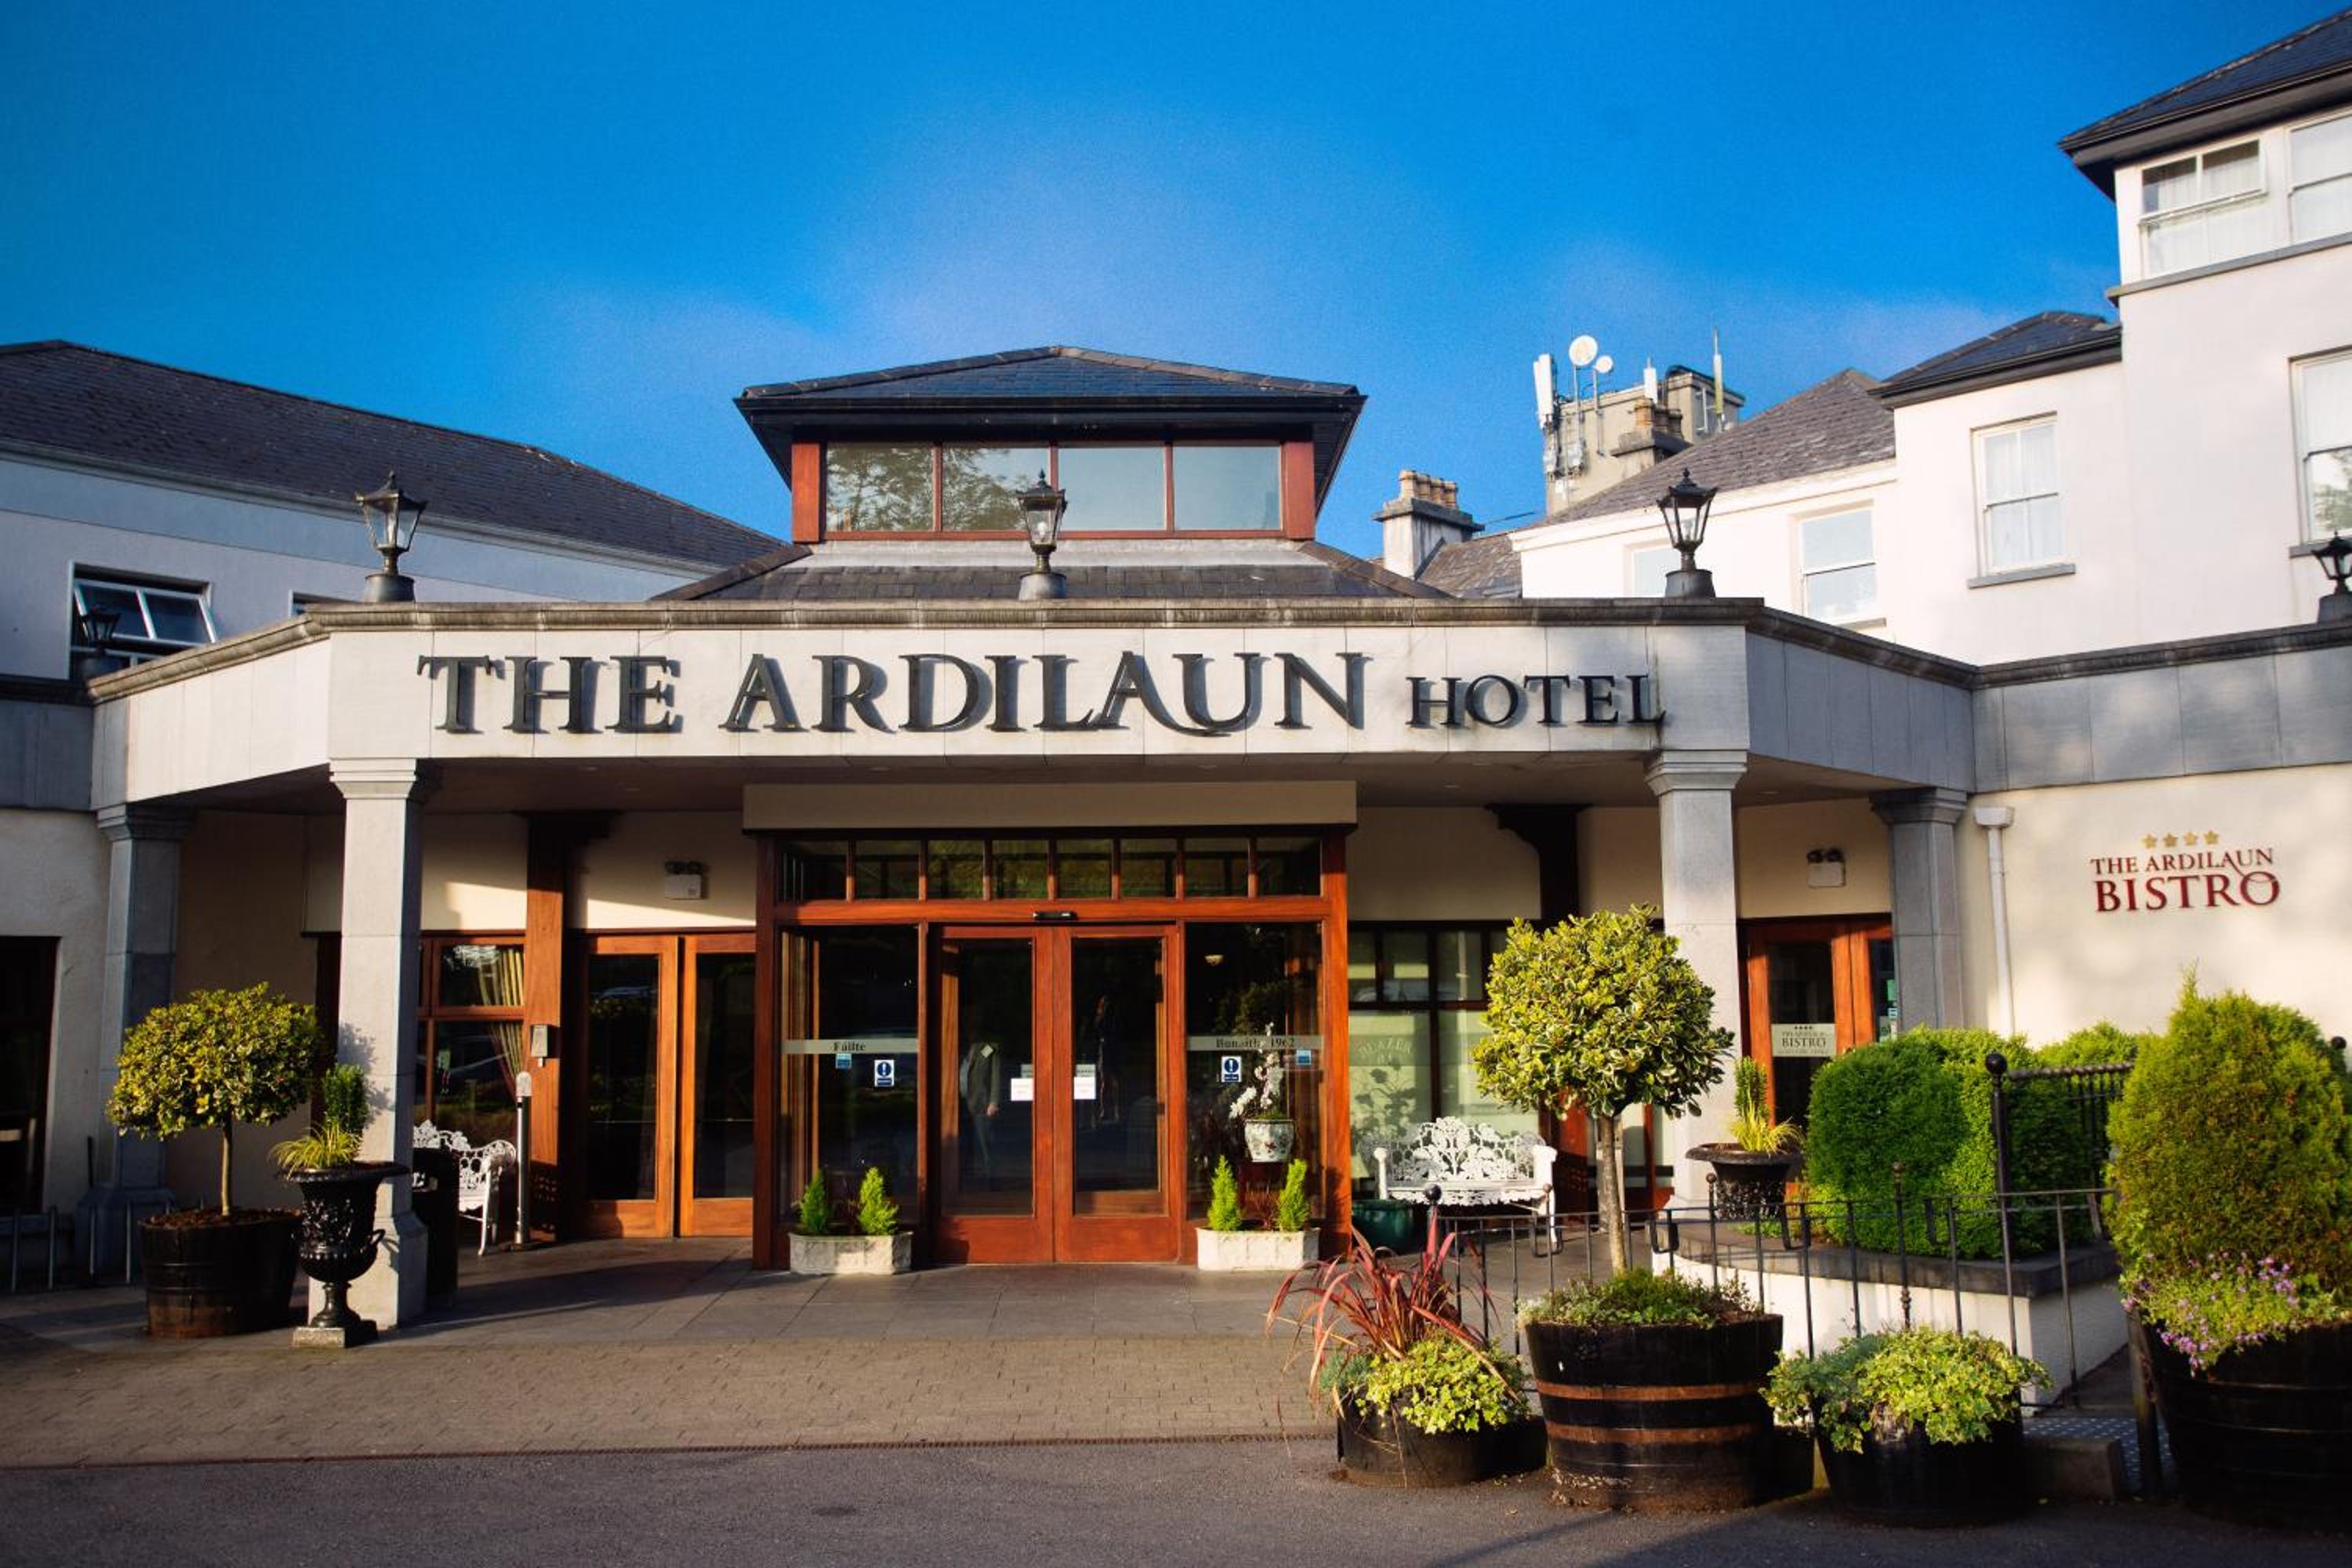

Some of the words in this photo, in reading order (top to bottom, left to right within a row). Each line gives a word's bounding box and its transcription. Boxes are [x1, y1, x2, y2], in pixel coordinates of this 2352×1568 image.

[416, 654, 677, 735] THE
[717, 650, 1367, 738] ARDILAUN
[1406, 673, 1666, 728] HOTEL
[2090, 857, 2139, 875] THE
[2145, 848, 2274, 881] ARDILAUN
[2094, 871, 2281, 913] BISTRO
[1781, 1037, 1826, 1047] BISTRO
